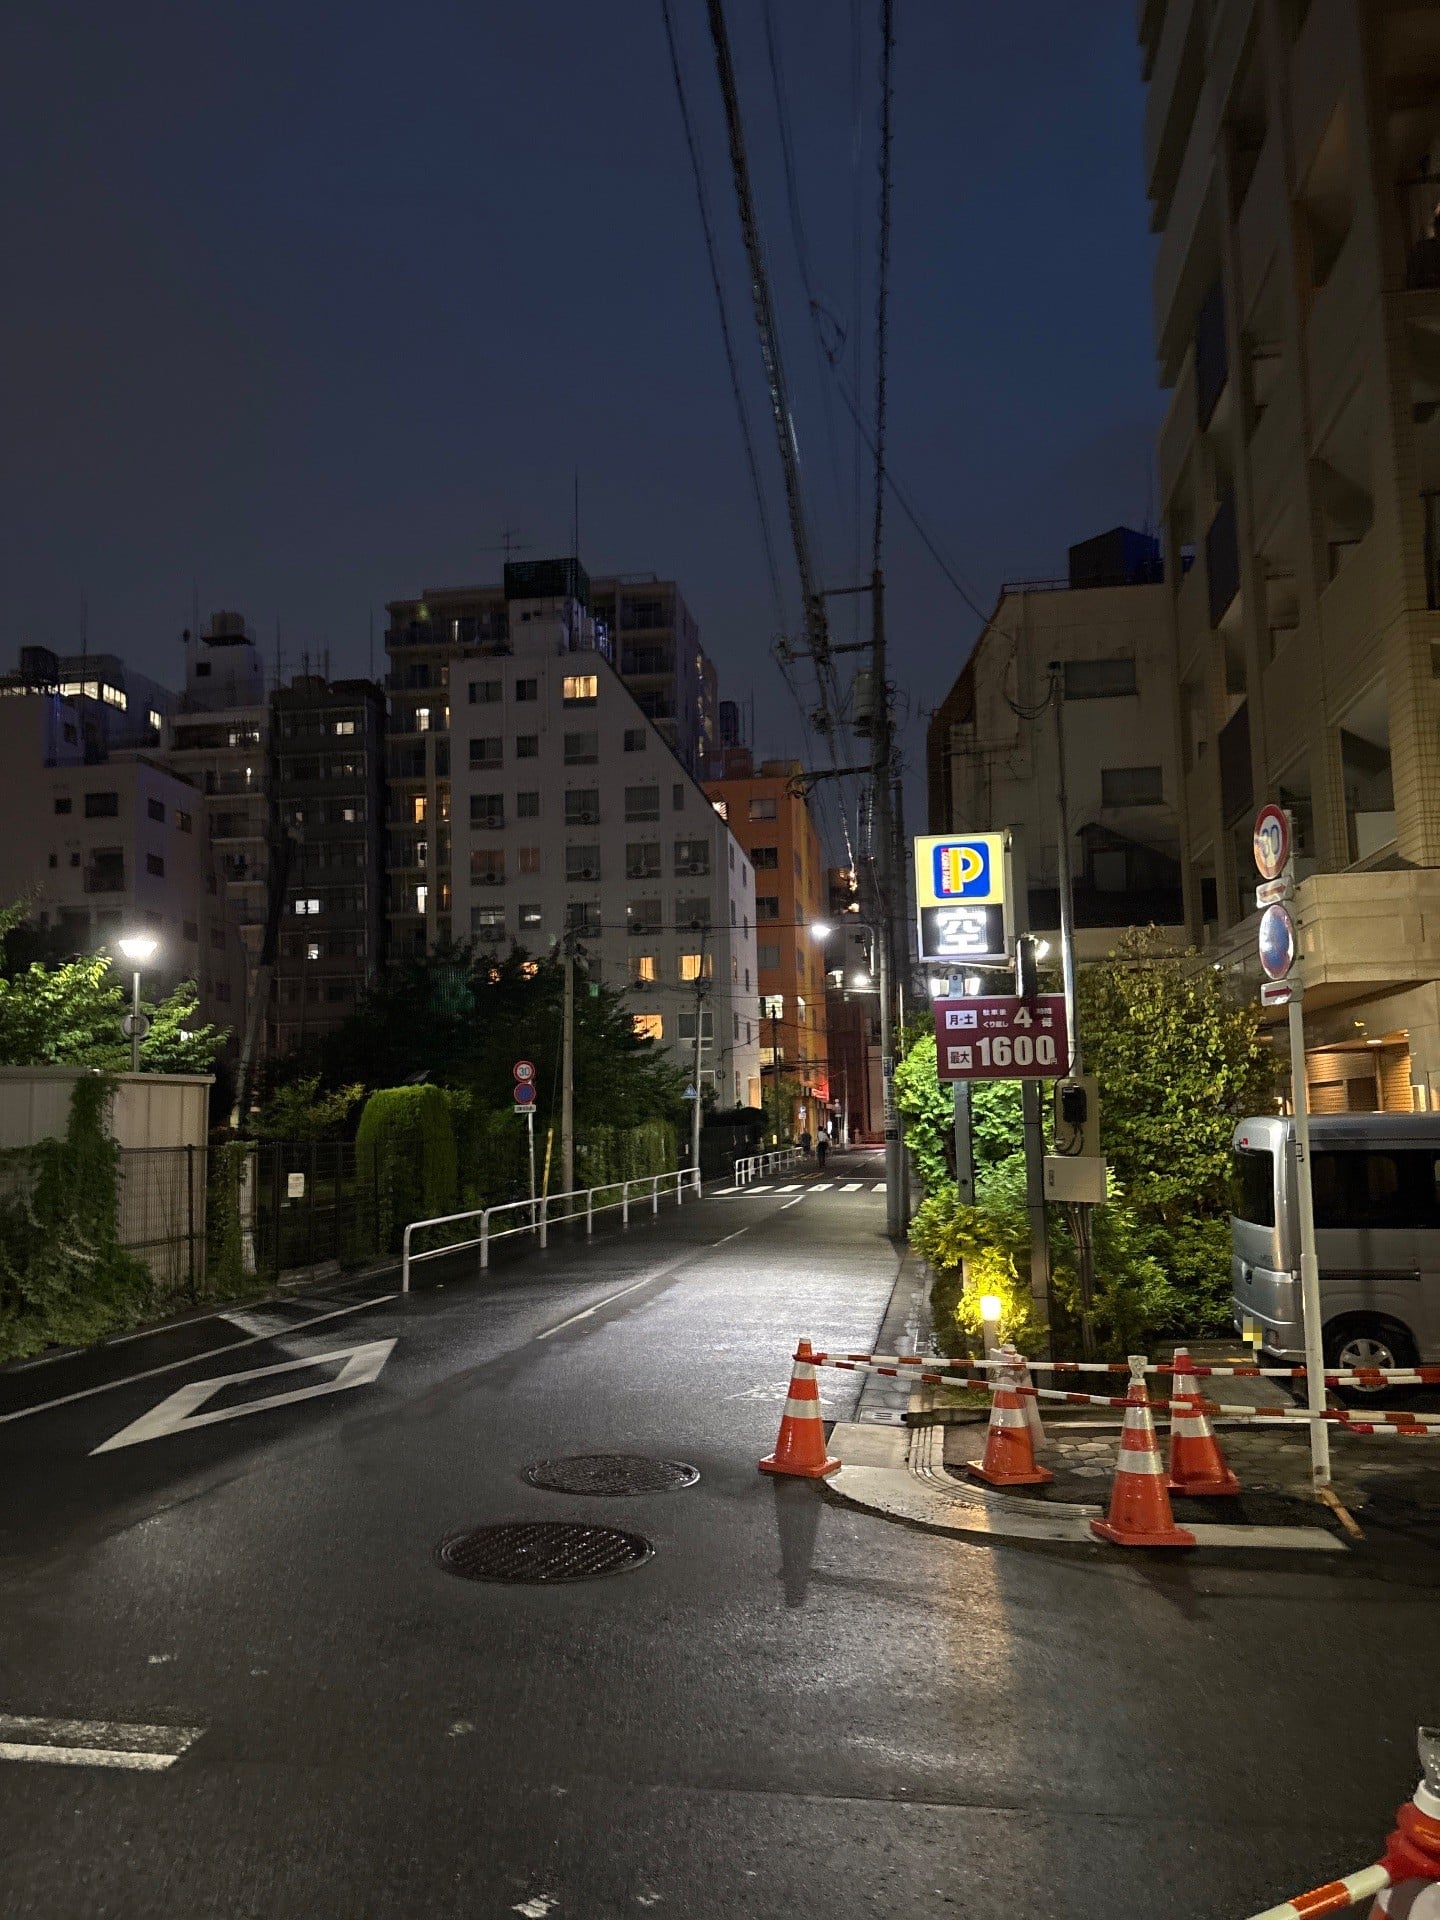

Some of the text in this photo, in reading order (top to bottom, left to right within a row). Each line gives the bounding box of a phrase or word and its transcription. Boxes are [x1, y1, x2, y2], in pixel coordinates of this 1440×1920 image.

[936, 907, 988, 954] 空
[1013, 1006, 1033, 1029] 4
[950, 1051, 970, 1065] 最大
[518, 1067, 531, 1077] 30
